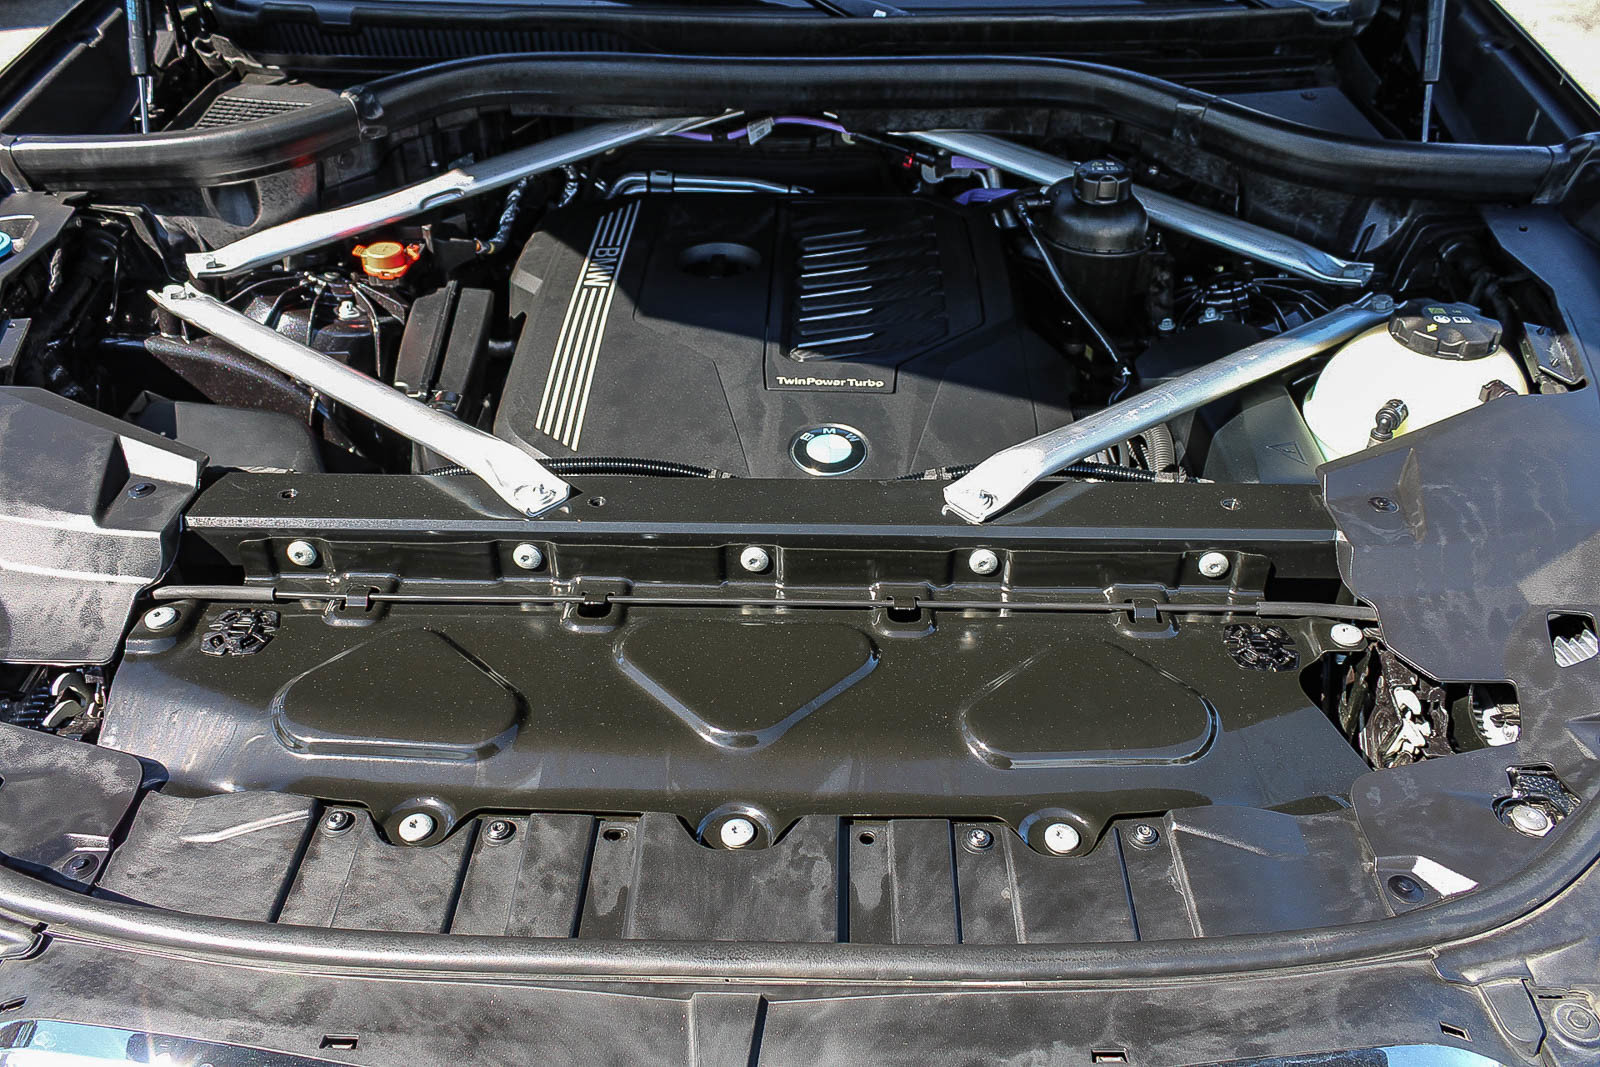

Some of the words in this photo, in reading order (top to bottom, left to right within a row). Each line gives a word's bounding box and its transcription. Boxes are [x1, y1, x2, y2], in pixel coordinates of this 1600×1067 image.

[583, 247, 621, 287] BMW
[846, 377, 885, 388] Turbo
[799, 427, 861, 442] BMW
